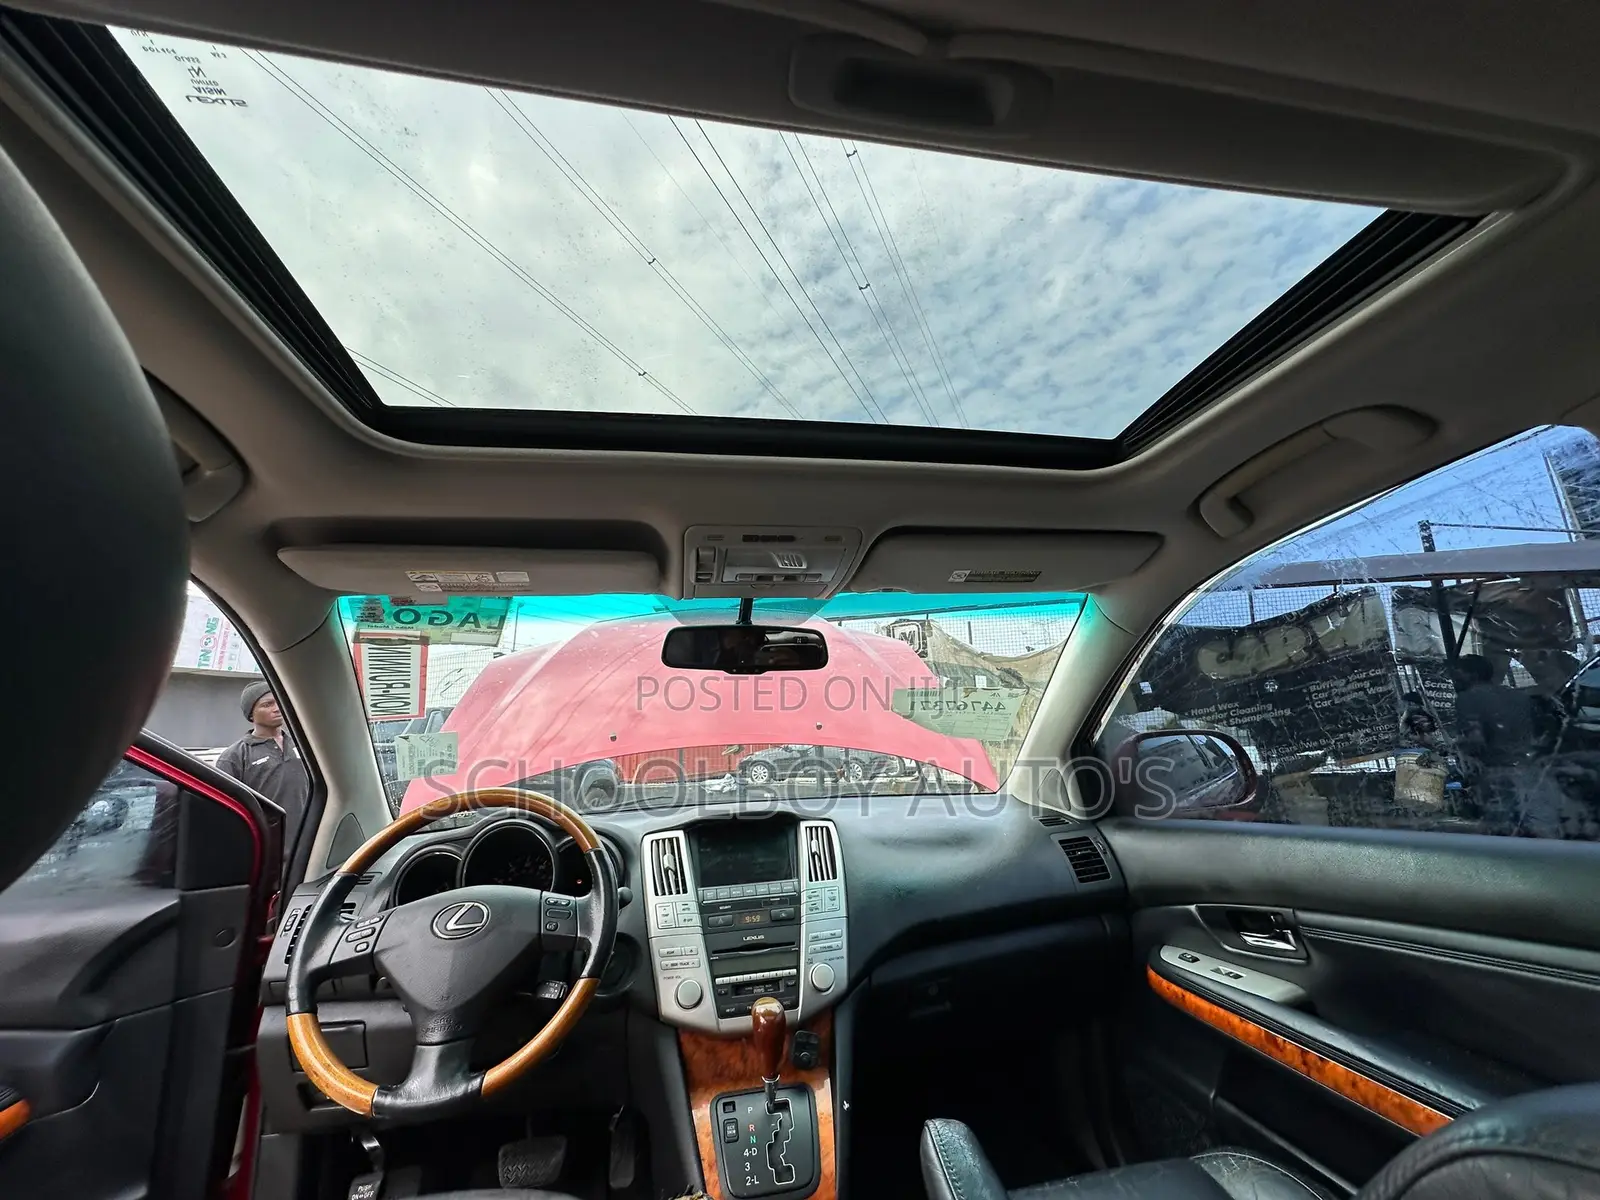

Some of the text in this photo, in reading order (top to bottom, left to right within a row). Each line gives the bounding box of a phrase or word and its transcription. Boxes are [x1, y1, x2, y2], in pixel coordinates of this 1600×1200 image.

[1314, 699, 1332, 708] Car
[1190, 701, 1240, 716] Hand Wax
[1229, 703, 1273, 717] Cleaning
[744, 914, 761, 923] 9:59
[747, 1106, 753, 1114] P
[748, 1124, 755, 1132] R
[750, 1135, 757, 1144] N
[744, 1162, 751, 1172] 3
